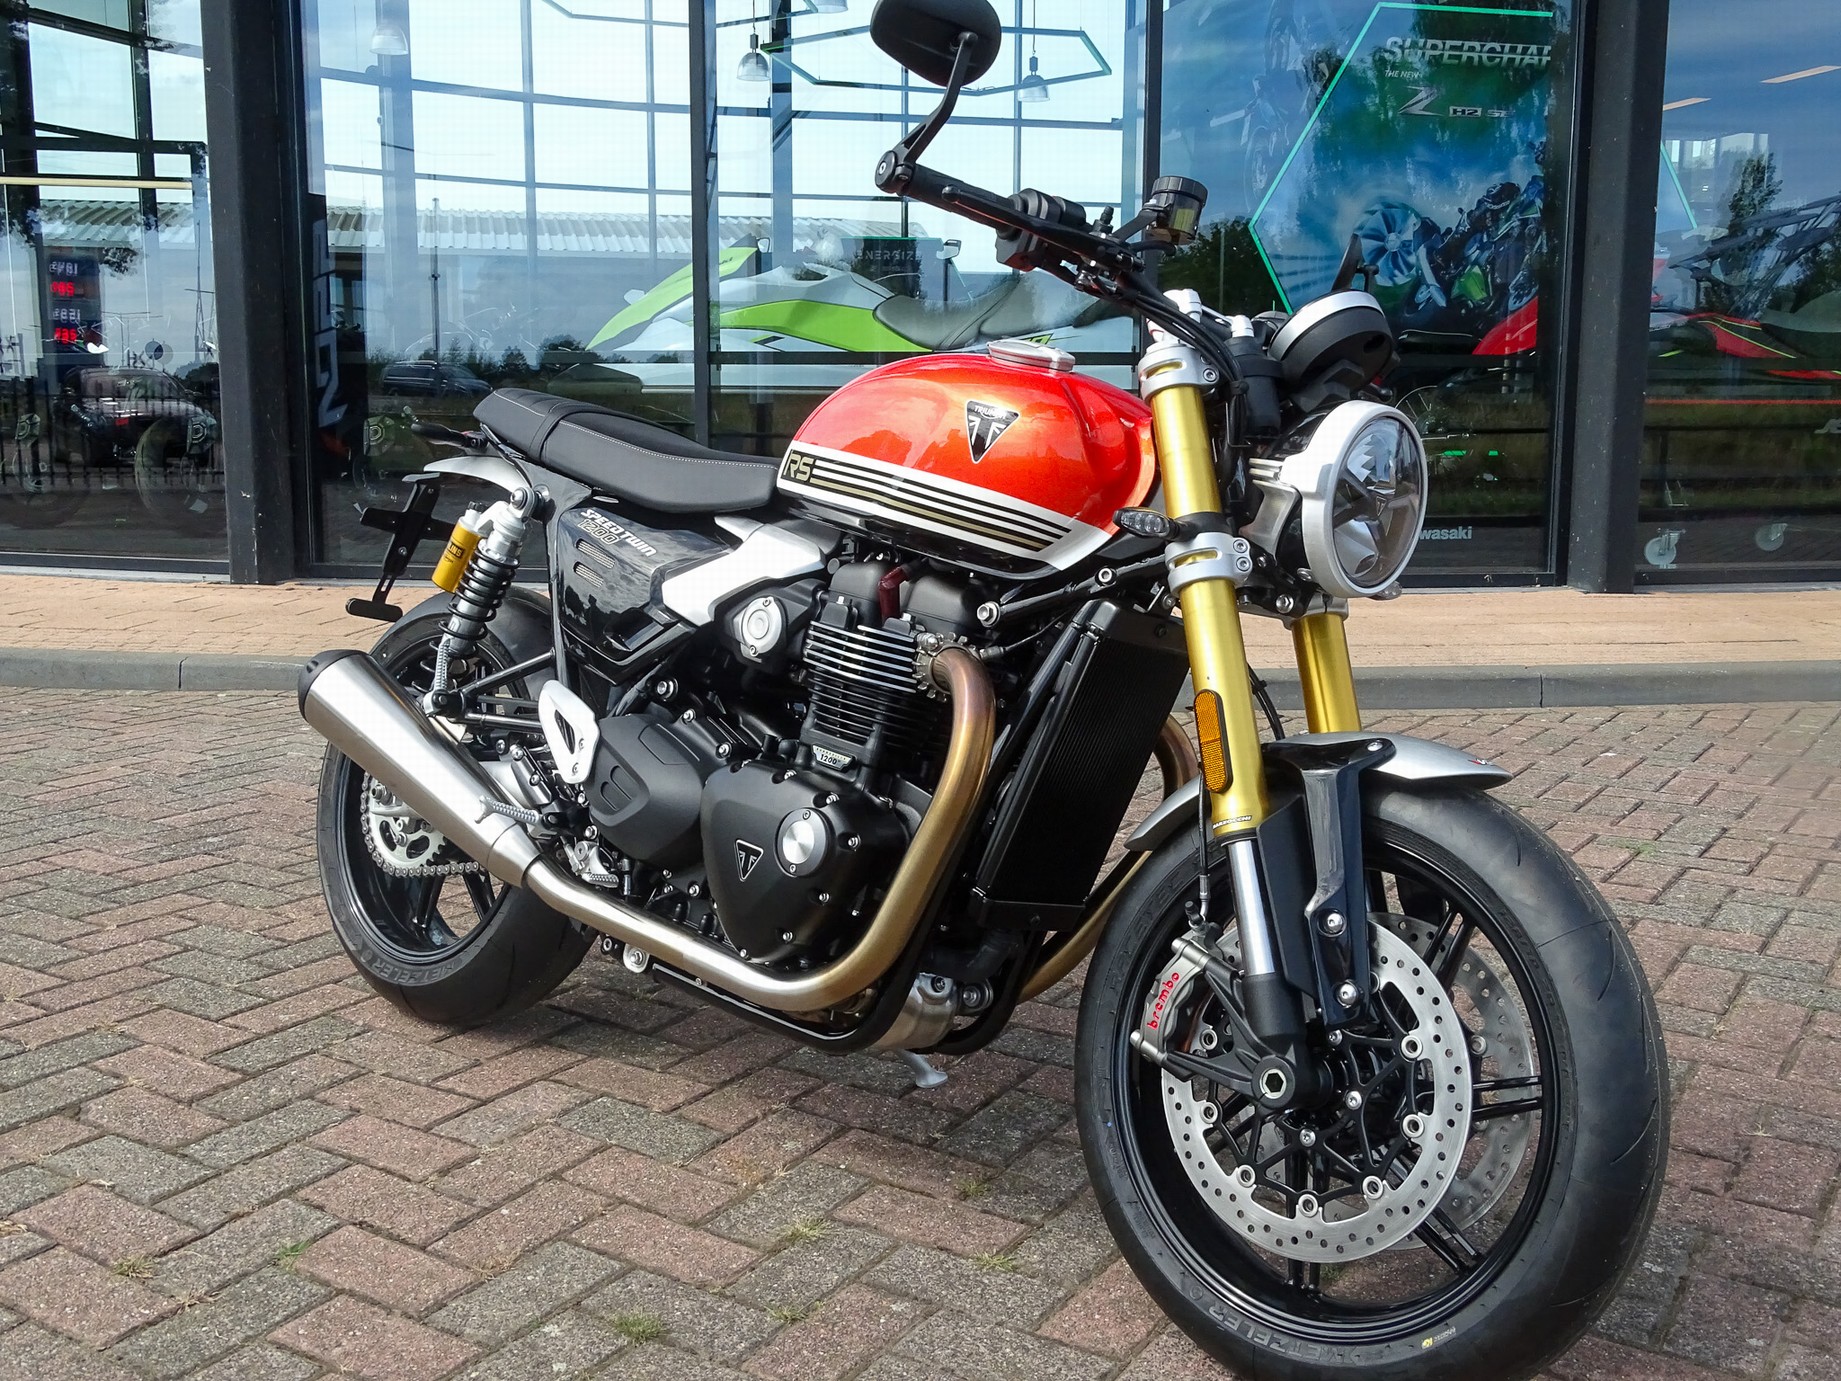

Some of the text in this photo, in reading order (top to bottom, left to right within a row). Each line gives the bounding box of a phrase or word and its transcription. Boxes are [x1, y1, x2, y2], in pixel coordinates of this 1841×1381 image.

[1450, 106, 1482, 118] H2
[783, 453, 814, 483] RS
[580, 508, 657, 557] SPEED TWIN
[1419, 525, 1473, 540] wasaki
[1147, 972, 1180, 1030] brembo
